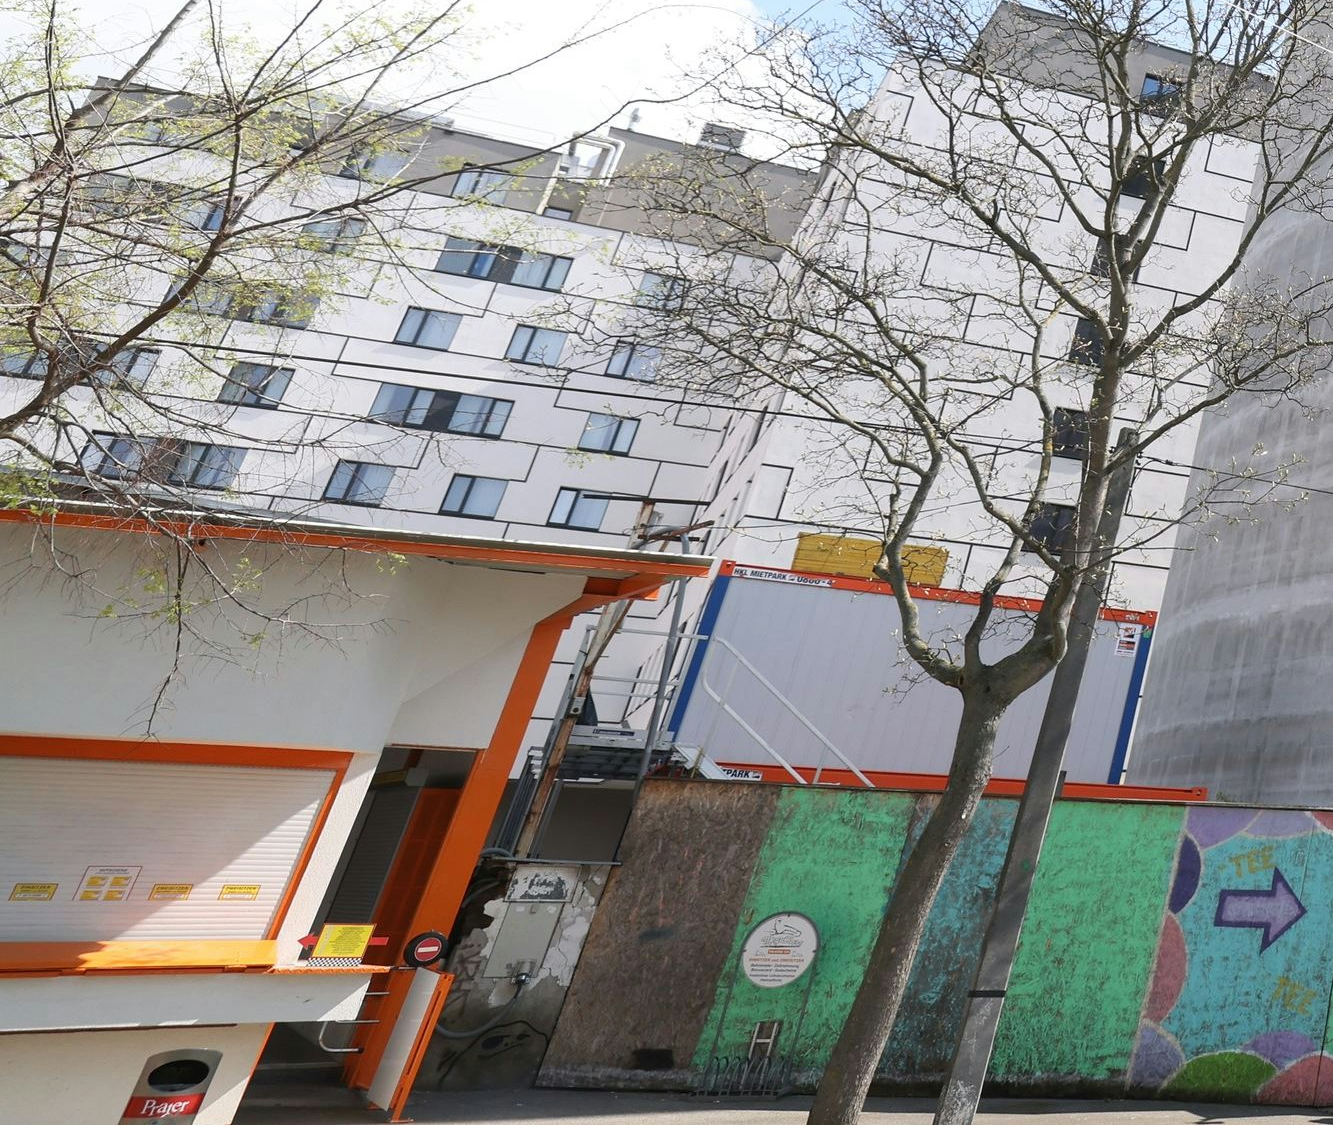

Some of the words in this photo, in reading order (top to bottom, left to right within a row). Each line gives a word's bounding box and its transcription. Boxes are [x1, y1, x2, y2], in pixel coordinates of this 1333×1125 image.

[733, 568, 748, 576] HKL
[750, 569, 787, 581] MIETPARK
[1229, 845, 1277, 879] TEE
[1271, 976, 1318, 1016] TEE
